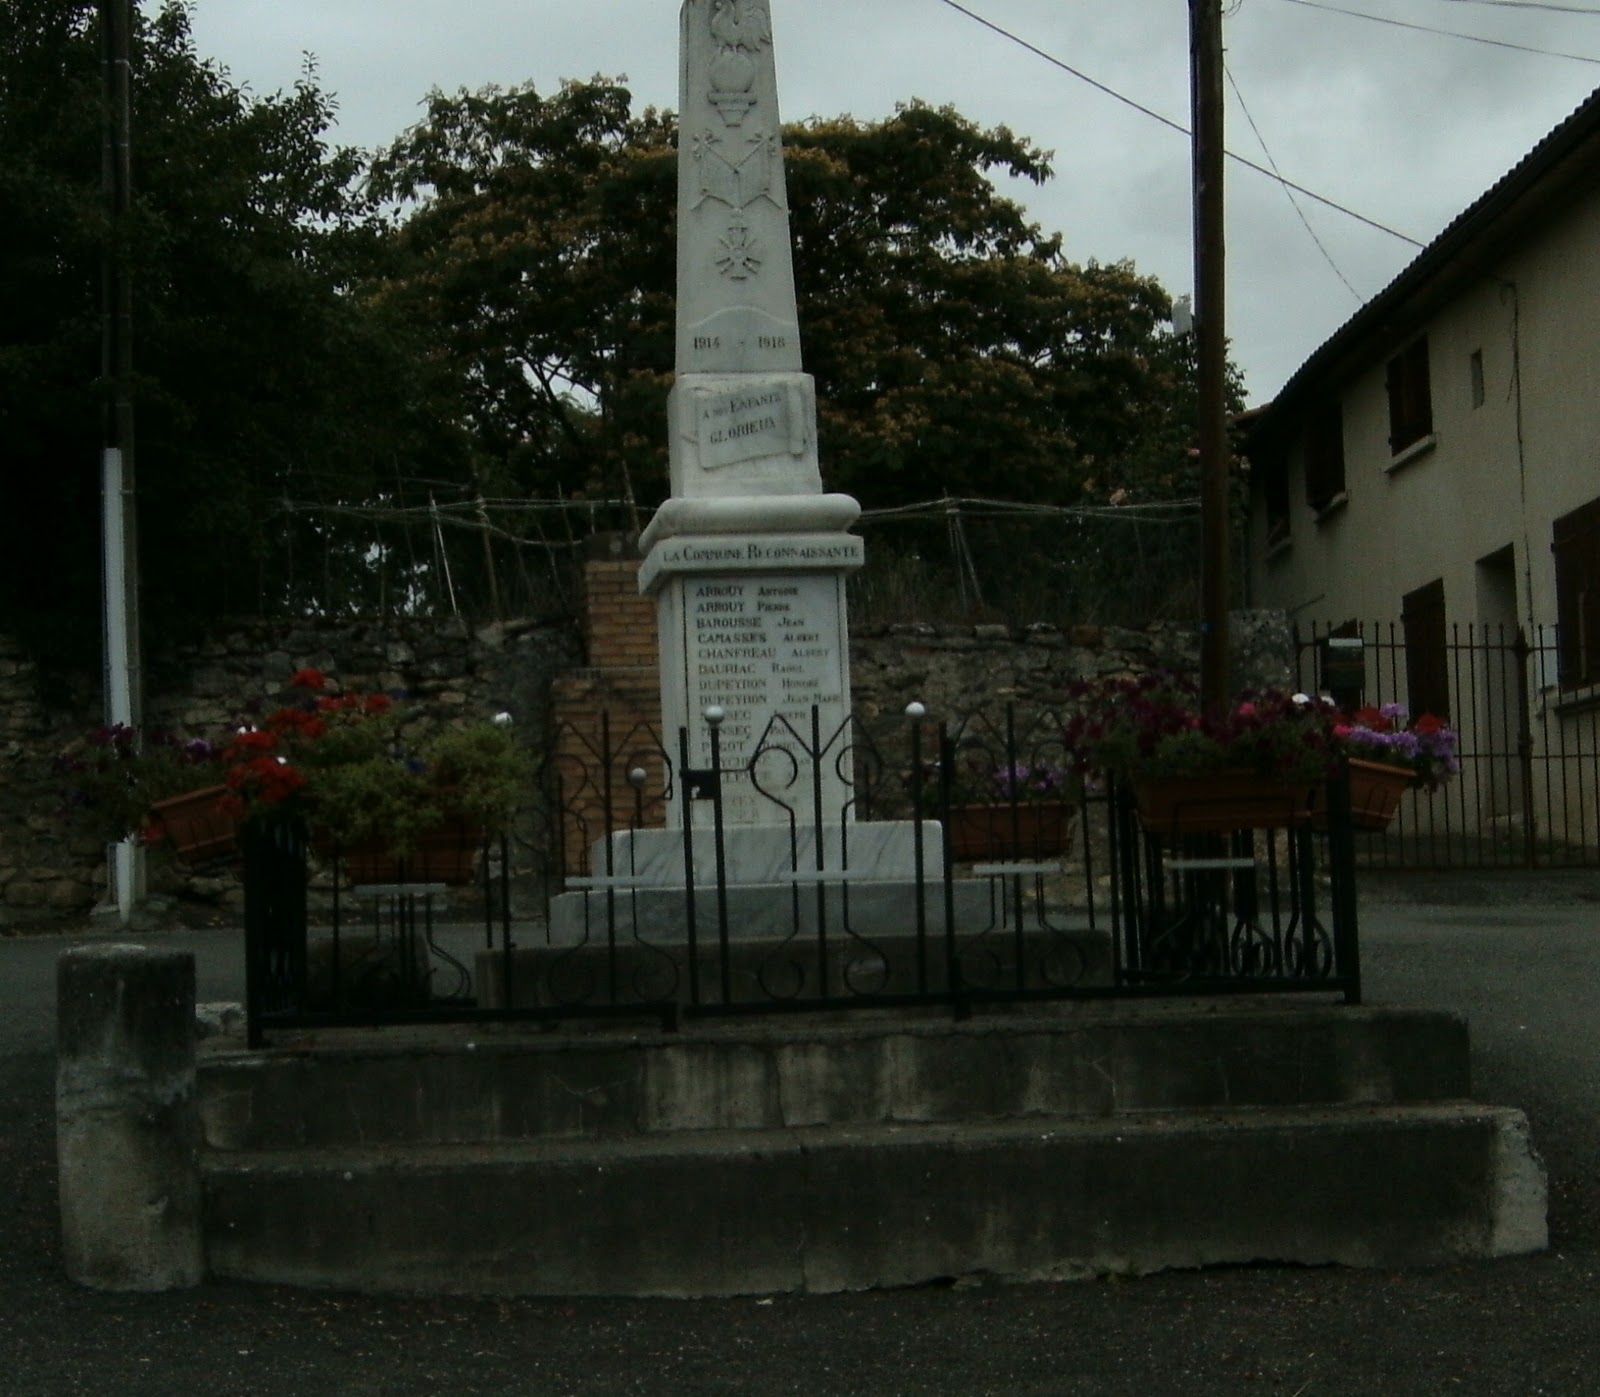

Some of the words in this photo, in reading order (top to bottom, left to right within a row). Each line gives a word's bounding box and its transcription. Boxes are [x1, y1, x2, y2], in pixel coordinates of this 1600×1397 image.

[694, 336, 720, 350] 1914
[758, 336, 785, 349] 1918
[710, 416, 776, 444] GLORIEUX
[663, 551, 681, 562] LA
[683, 545, 742, 561] COMMUNE
[747, 543, 858, 559] RECONNAISSANTE
[696, 585, 743, 597] ARROUY
[697, 601, 744, 613] ARROUY
[757, 601, 791, 612] PIERRE
[696, 616, 762, 629] BAROUSSE
[777, 617, 804, 628] JEAN
[697, 632, 767, 644] CAMASSES
[784, 633, 819, 643] ALBERT
